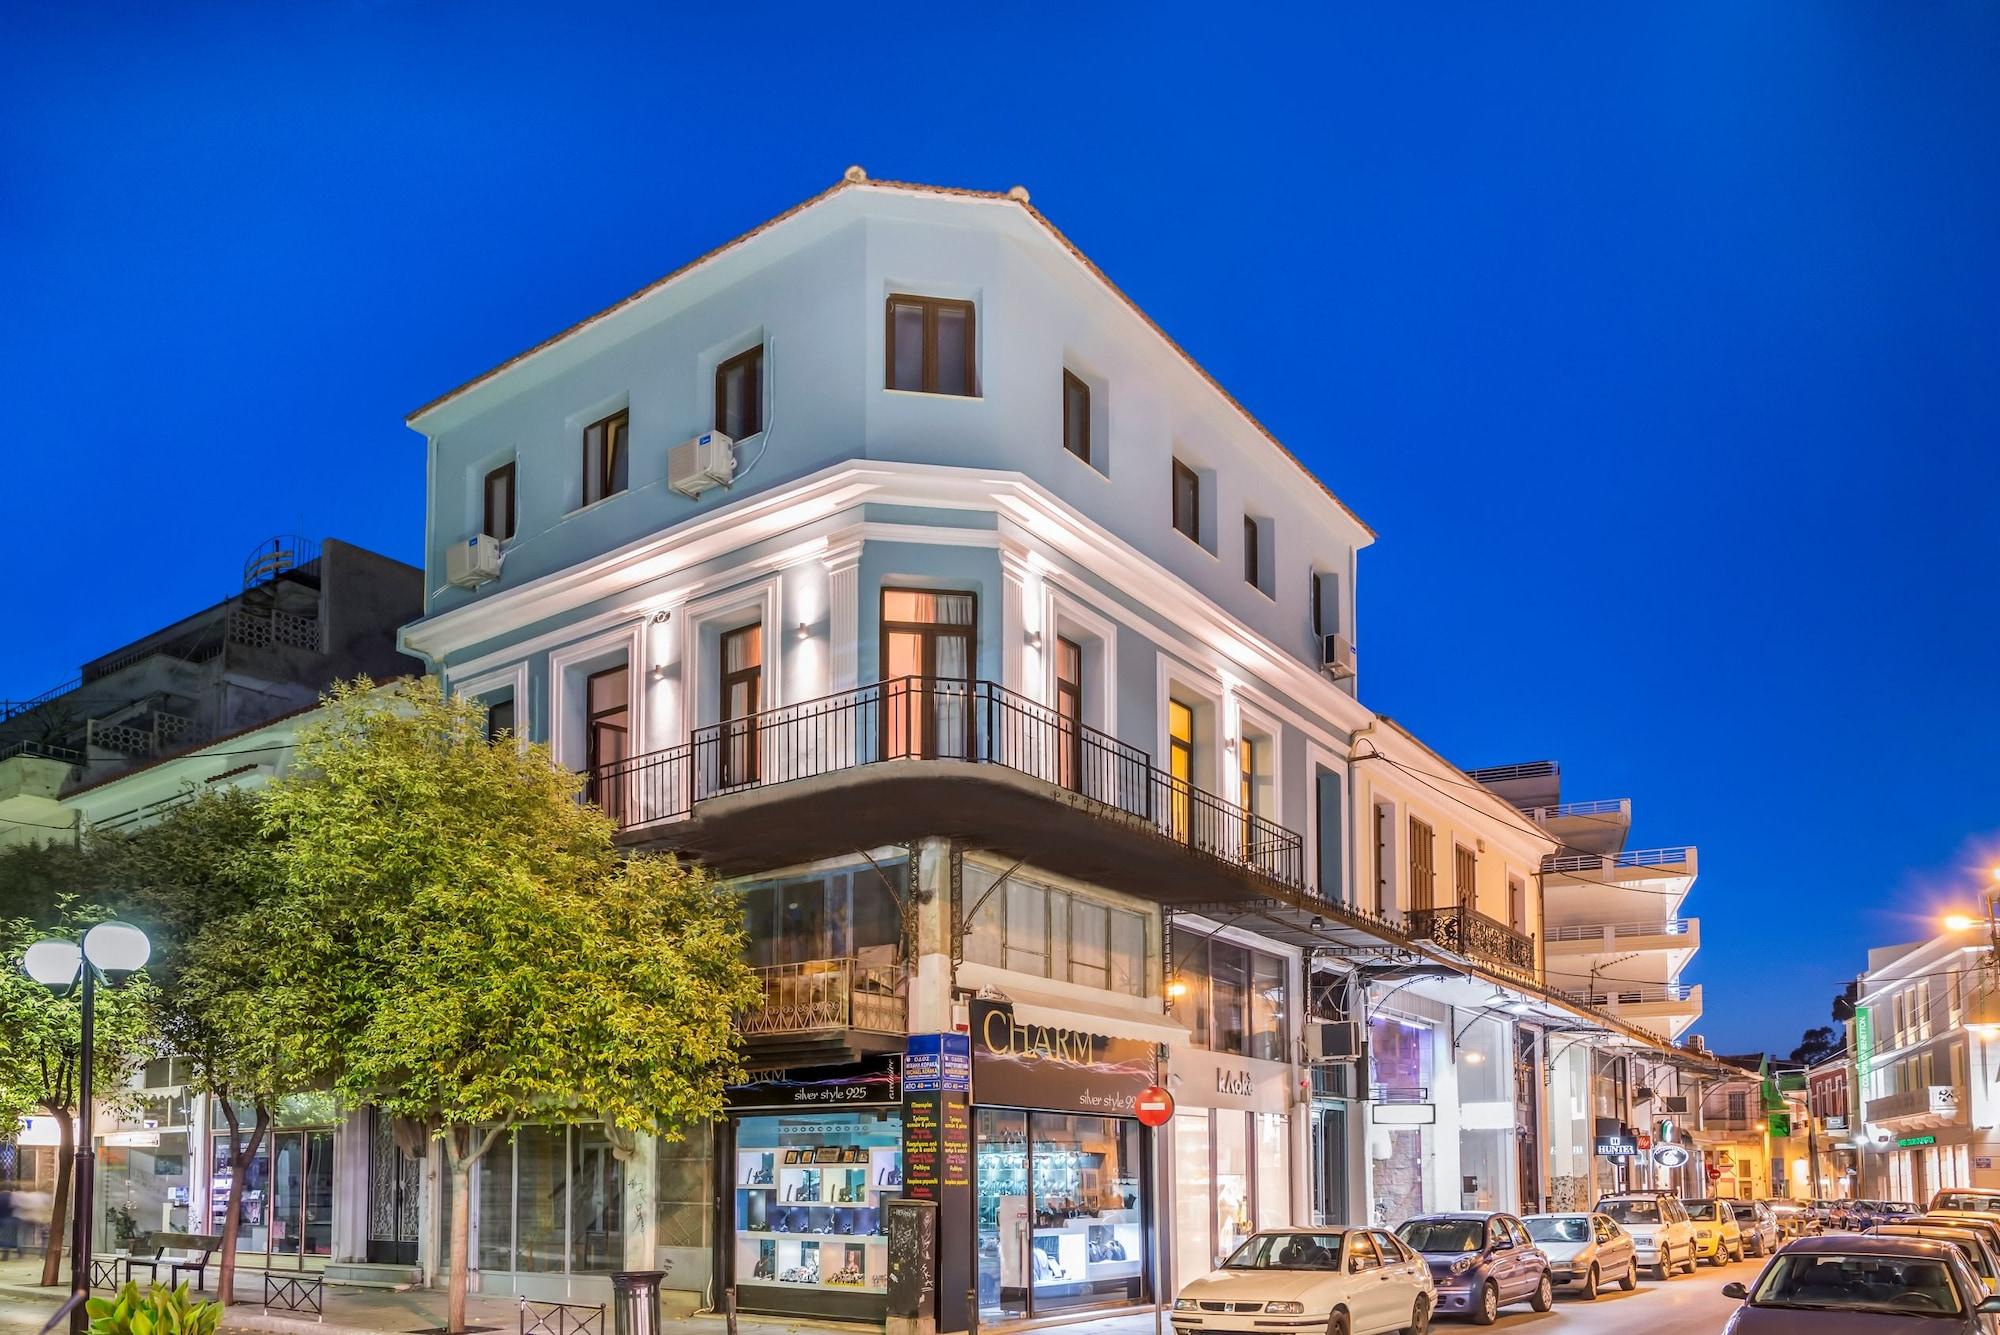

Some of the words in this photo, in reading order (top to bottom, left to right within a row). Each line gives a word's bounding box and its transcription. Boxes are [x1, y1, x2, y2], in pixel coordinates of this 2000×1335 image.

[983, 1010, 1094, 1066] CHARM
[1858, 1016, 1867, 1050] BENETTON
[794, 1087, 819, 1101] silver
[820, 1086, 845, 1103] style
[845, 1086, 867, 1100] 925
[1079, 1088, 1102, 1106] silver
[1103, 1091, 1125, 1112] style
[1125, 1094, 1137, 1110] 92
